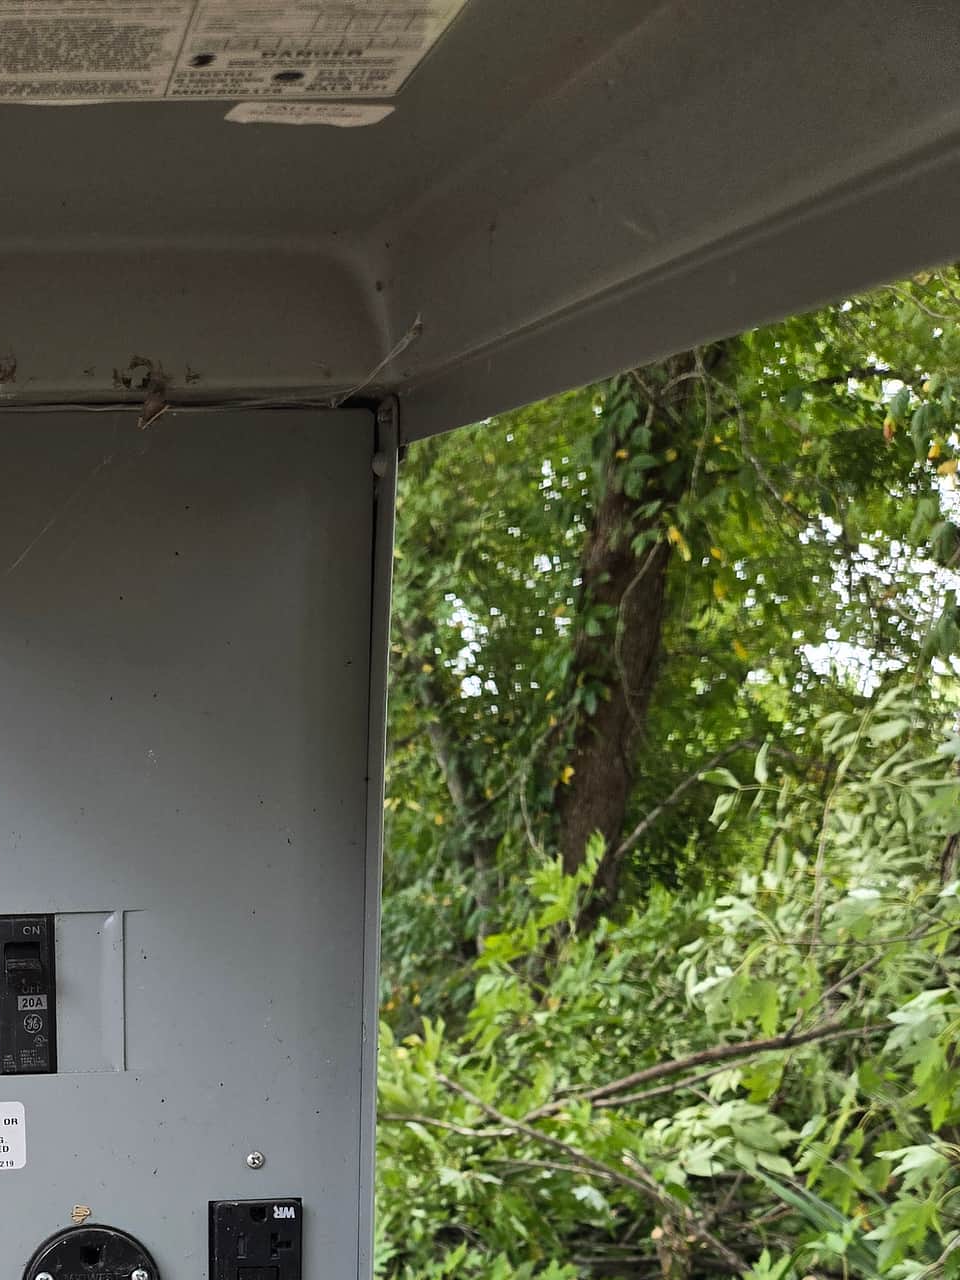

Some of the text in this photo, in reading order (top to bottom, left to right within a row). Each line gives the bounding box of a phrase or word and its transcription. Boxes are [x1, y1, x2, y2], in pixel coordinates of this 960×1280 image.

[23, 926, 40, 935] ON
[22, 997, 43, 1008] 20A
[3, 1118, 18, 1126] OR
[272, 1205, 296, 1219] WR
